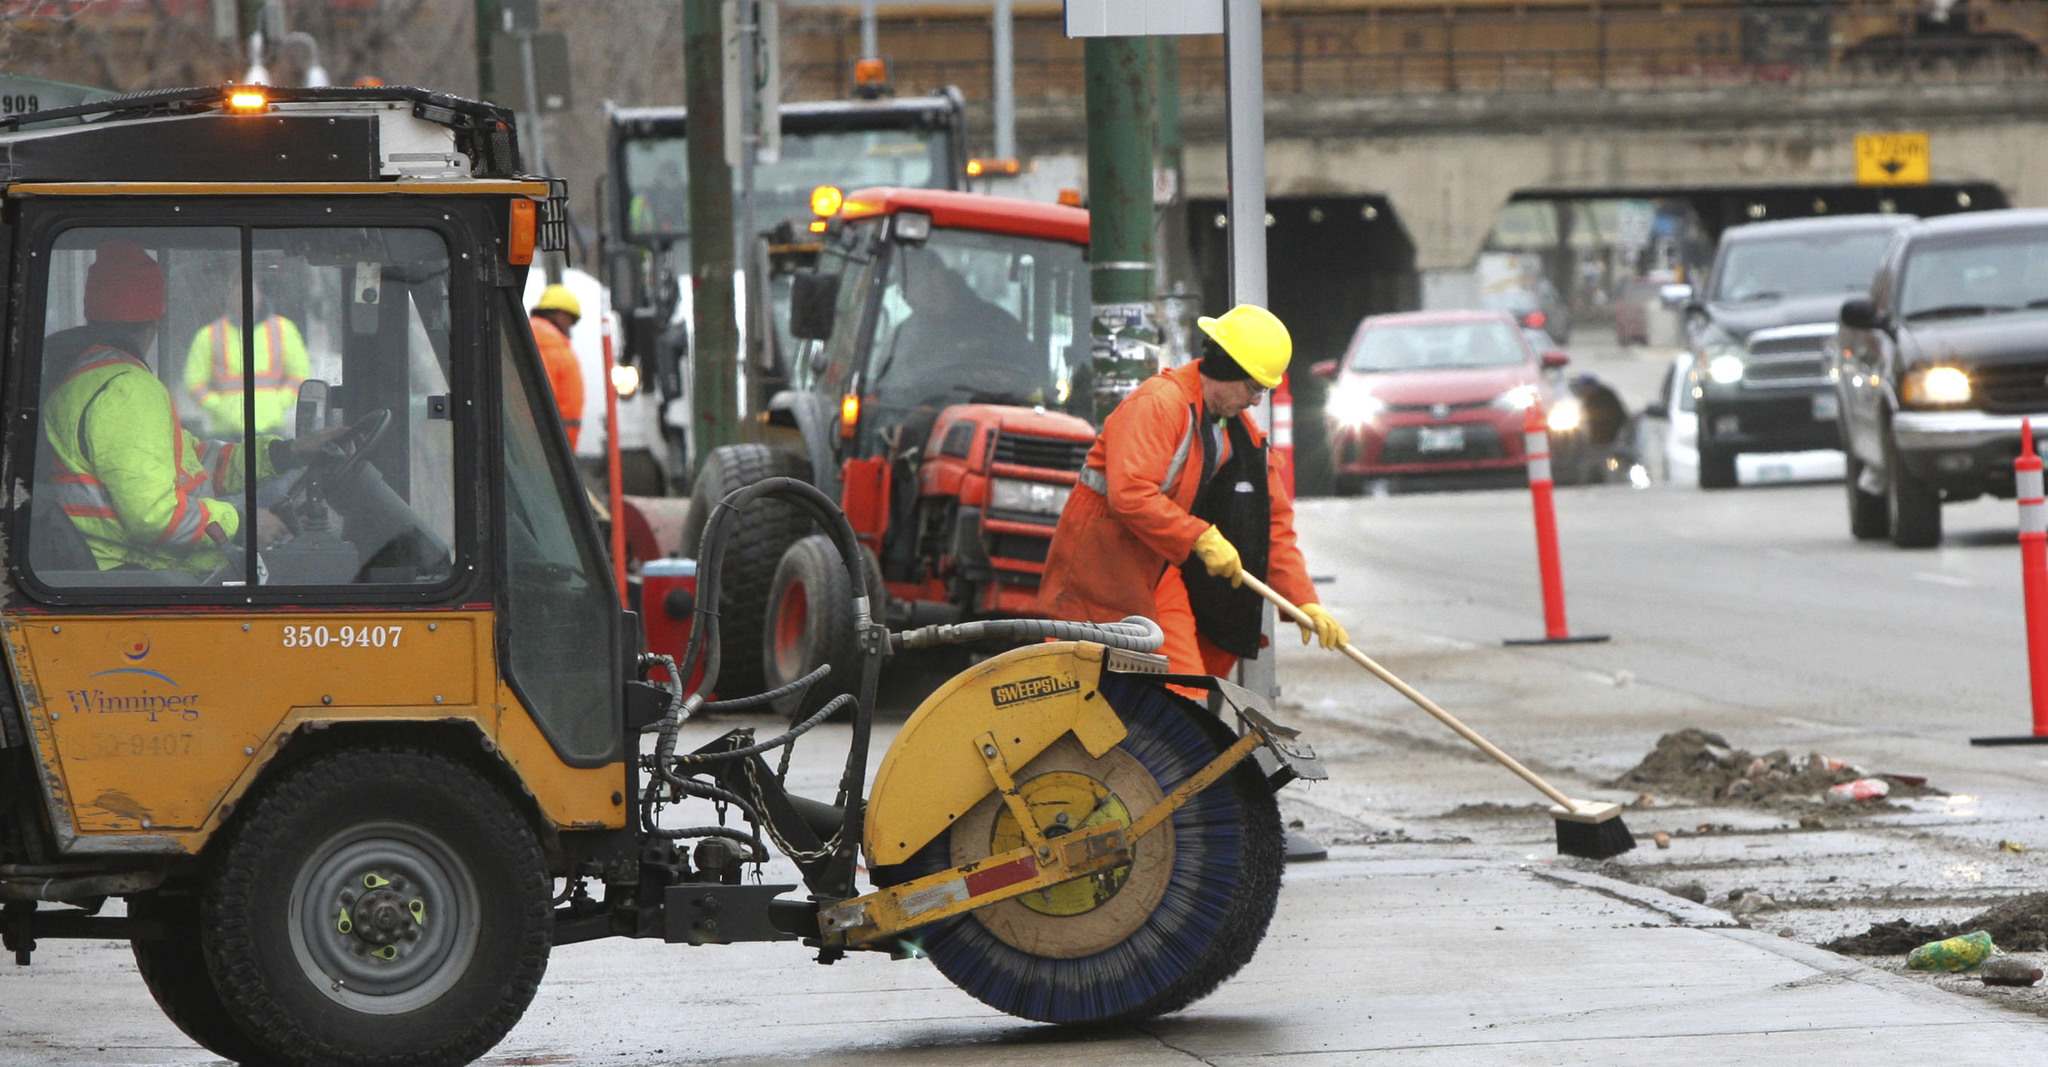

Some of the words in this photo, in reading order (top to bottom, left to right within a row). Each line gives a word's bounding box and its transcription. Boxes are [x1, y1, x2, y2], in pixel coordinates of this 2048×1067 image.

[3, 95, 38, 113] 909
[283, 625, 402, 648] 350-9407
[66, 689, 199, 722] Winnipeg
[73, 733, 193, 757] 50-9407
